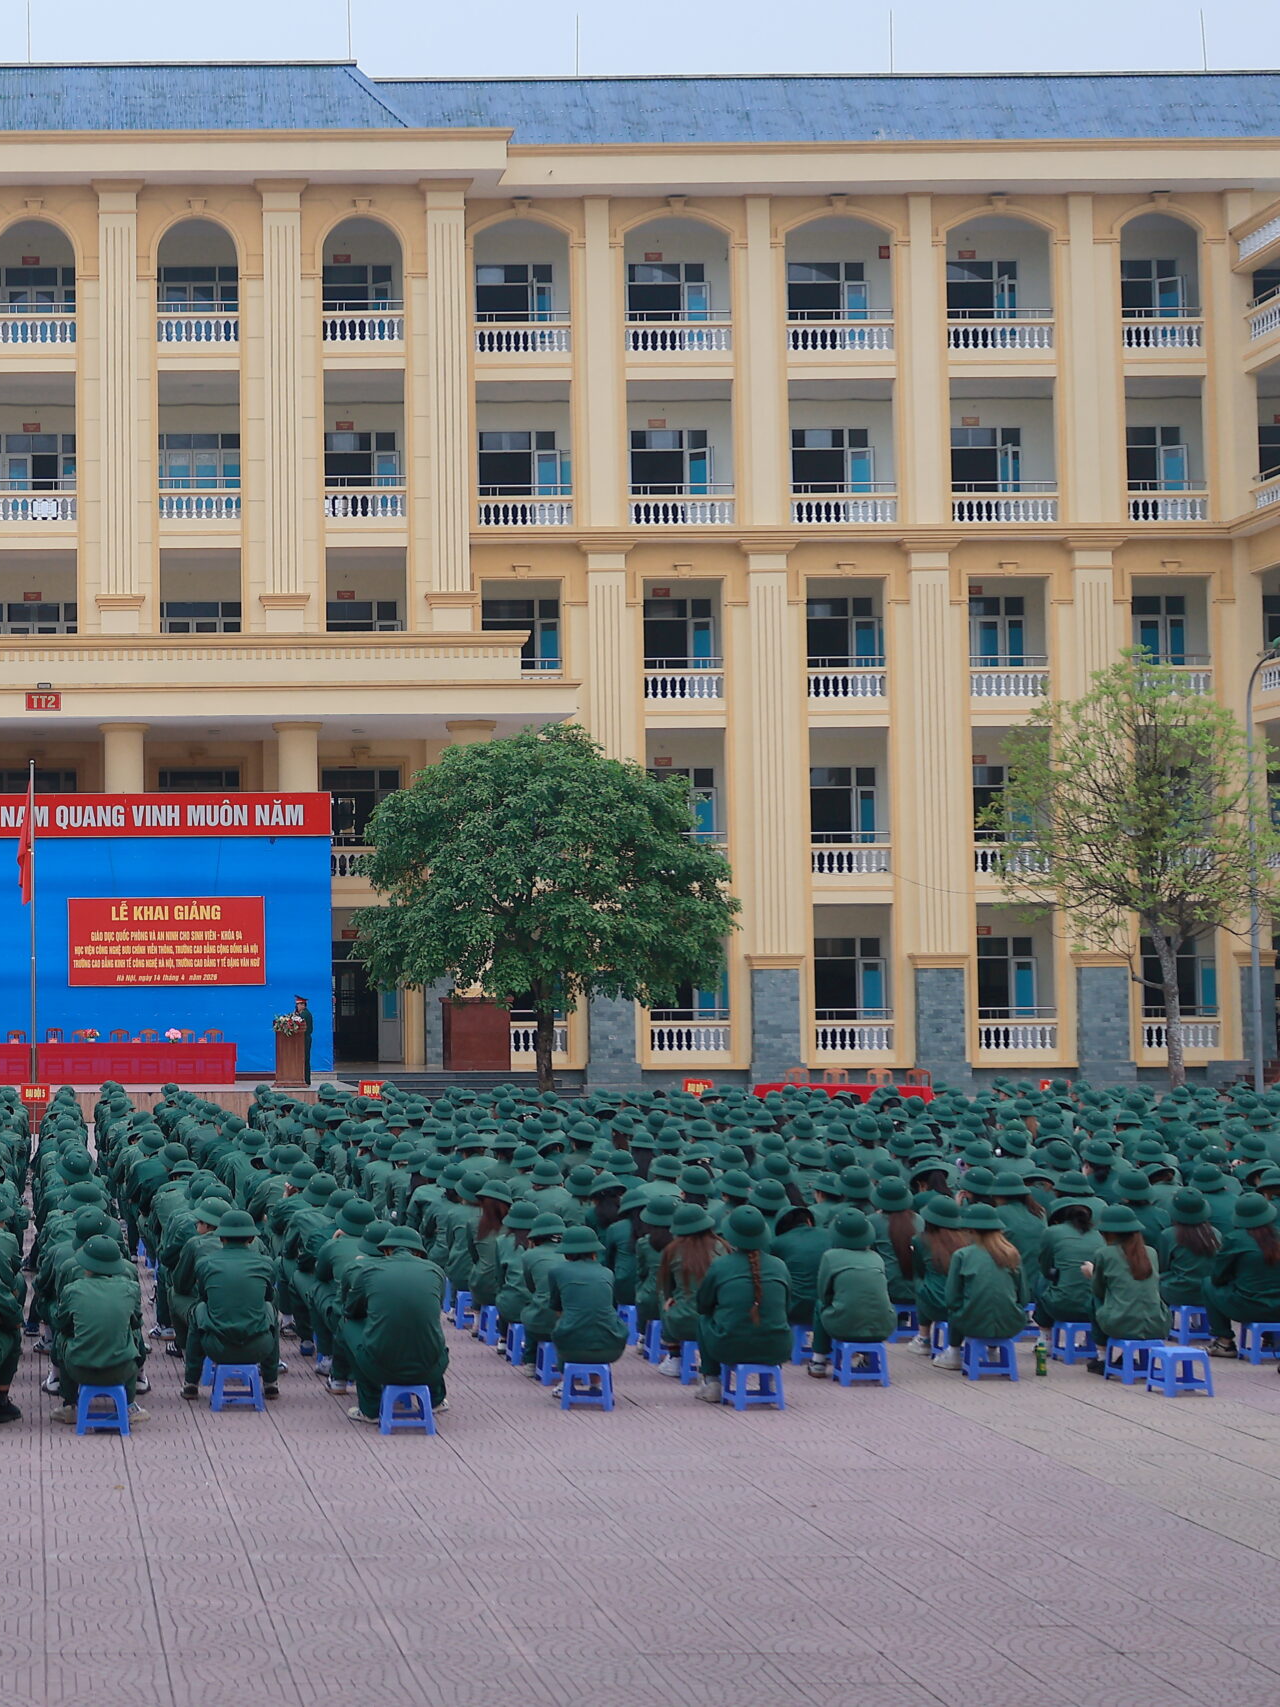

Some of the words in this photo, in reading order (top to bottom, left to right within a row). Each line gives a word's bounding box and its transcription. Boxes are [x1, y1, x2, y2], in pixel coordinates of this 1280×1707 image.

[32, 696, 56, 708] TT2
[56, 805, 125, 830] QUANG
[132, 804, 180, 828] VINH
[187, 800, 248, 827] MUÔN
[256, 800, 304, 826] NĂM
[112, 900, 128, 920] LỄ
[134, 906, 169, 920] KHAI
[174, 900, 221, 920] GIẢNG
[91, 930, 104, 941] GIÁO
[104, 931, 114, 943] DỤC
[116, 928, 129, 942] QUỐC
[131, 930, 148, 941] PHÒNG
[149, 930, 156, 941] VÀ
[157, 931, 164, 941] AN
[166, 931, 178, 941] NINH
[180, 931, 190, 941] CHO
[191, 931, 204, 940] SINH
[205, 929, 216, 940] VIÊN
[221, 929, 234, 940] KHÓA
[75, 946, 84, 956] HỌC
[85, 945, 95, 956] VIỆN
[96, 945, 108, 955] CÔNG
[109, 945, 121, 956] NGHỆ
[122, 945, 131, 954] BƯU
[132, 944, 146, 954] CHÍNH
[147, 943, 157, 954] VIỄN
[176, 944, 192, 954] TRƯỜNG
[194, 945, 202, 954] CAO
[204, 942, 216, 954] ĐẲNG
[217, 944, 229, 955] CỘNG
[243, 944, 249, 954] HÀ
[250, 944, 258, 955] NỘI
[73, 958, 91, 968] TRƯỜNG
[92, 959, 100, 968] CAO
[102, 956, 114, 968] ĐẲNG
[115, 959, 125, 968] KINH
[126, 957, 132, 968] TẾ
[133, 958, 145, 968] CÔNG
[146, 957, 158, 969] NGHỆ
[159, 958, 164, 968] HÀ
[176, 957, 193, 967] TRƯỜNG
[194, 958, 203, 967] CAO
[204, 955, 216, 967] ĐẲNG
[217, 959, 220, 967] Y
[221, 957, 226, 967] TẾ
[227, 957, 239, 968] ĐẶNG
[240, 957, 249, 967] VĂN
[250, 957, 260, 967] NGỮ
[126, 974, 137, 983] Nội,
